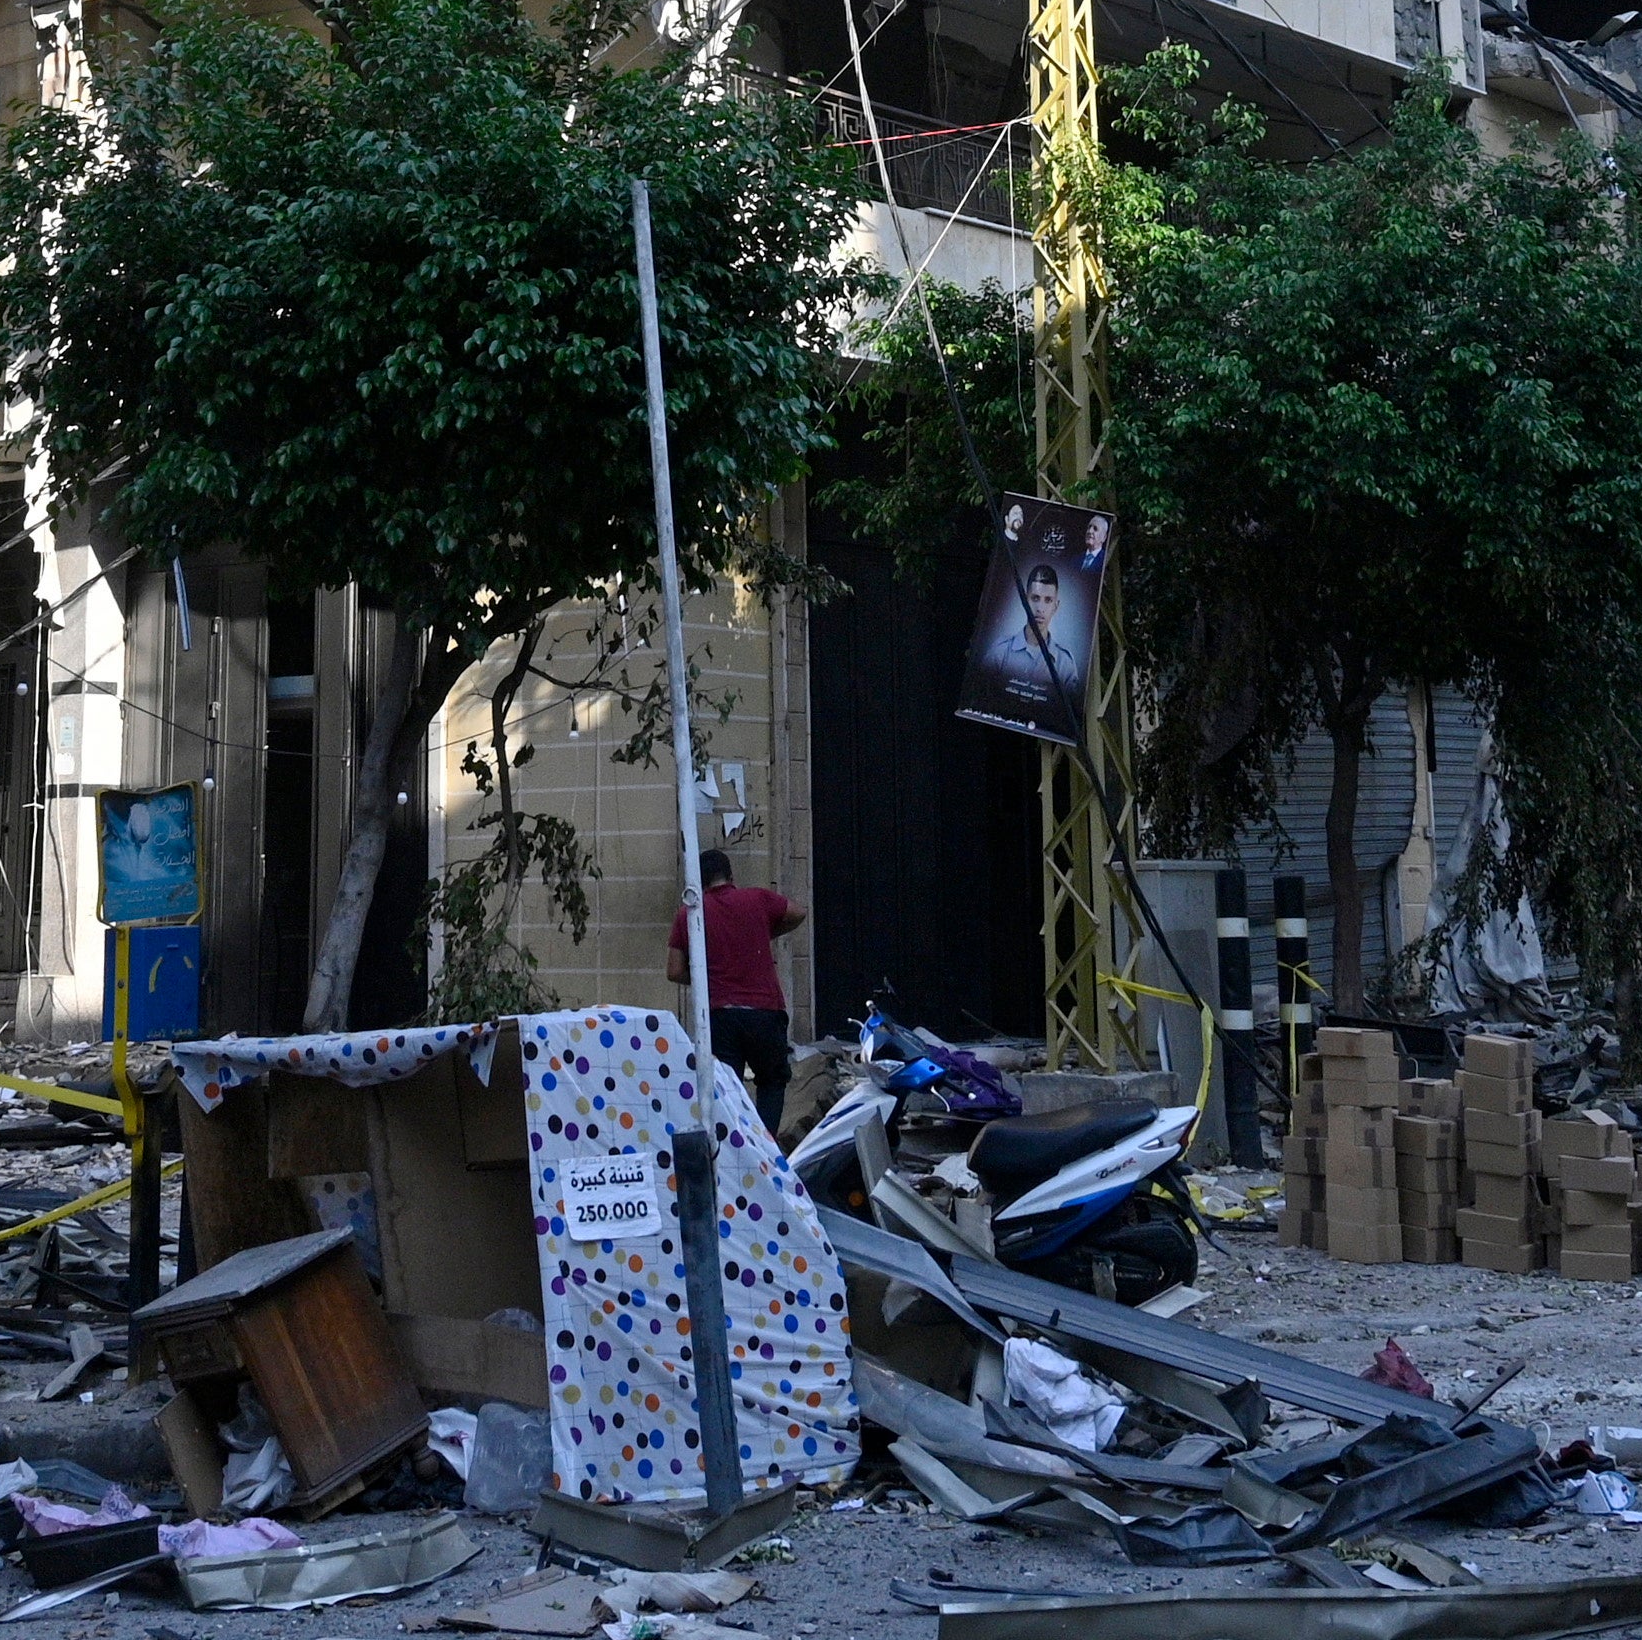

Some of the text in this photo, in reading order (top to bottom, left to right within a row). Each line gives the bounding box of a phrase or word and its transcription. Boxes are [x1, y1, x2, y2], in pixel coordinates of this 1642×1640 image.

[570, 1164, 644, 1192] قنينة كبيرة
[576, 1200, 648, 1223] 250.000
